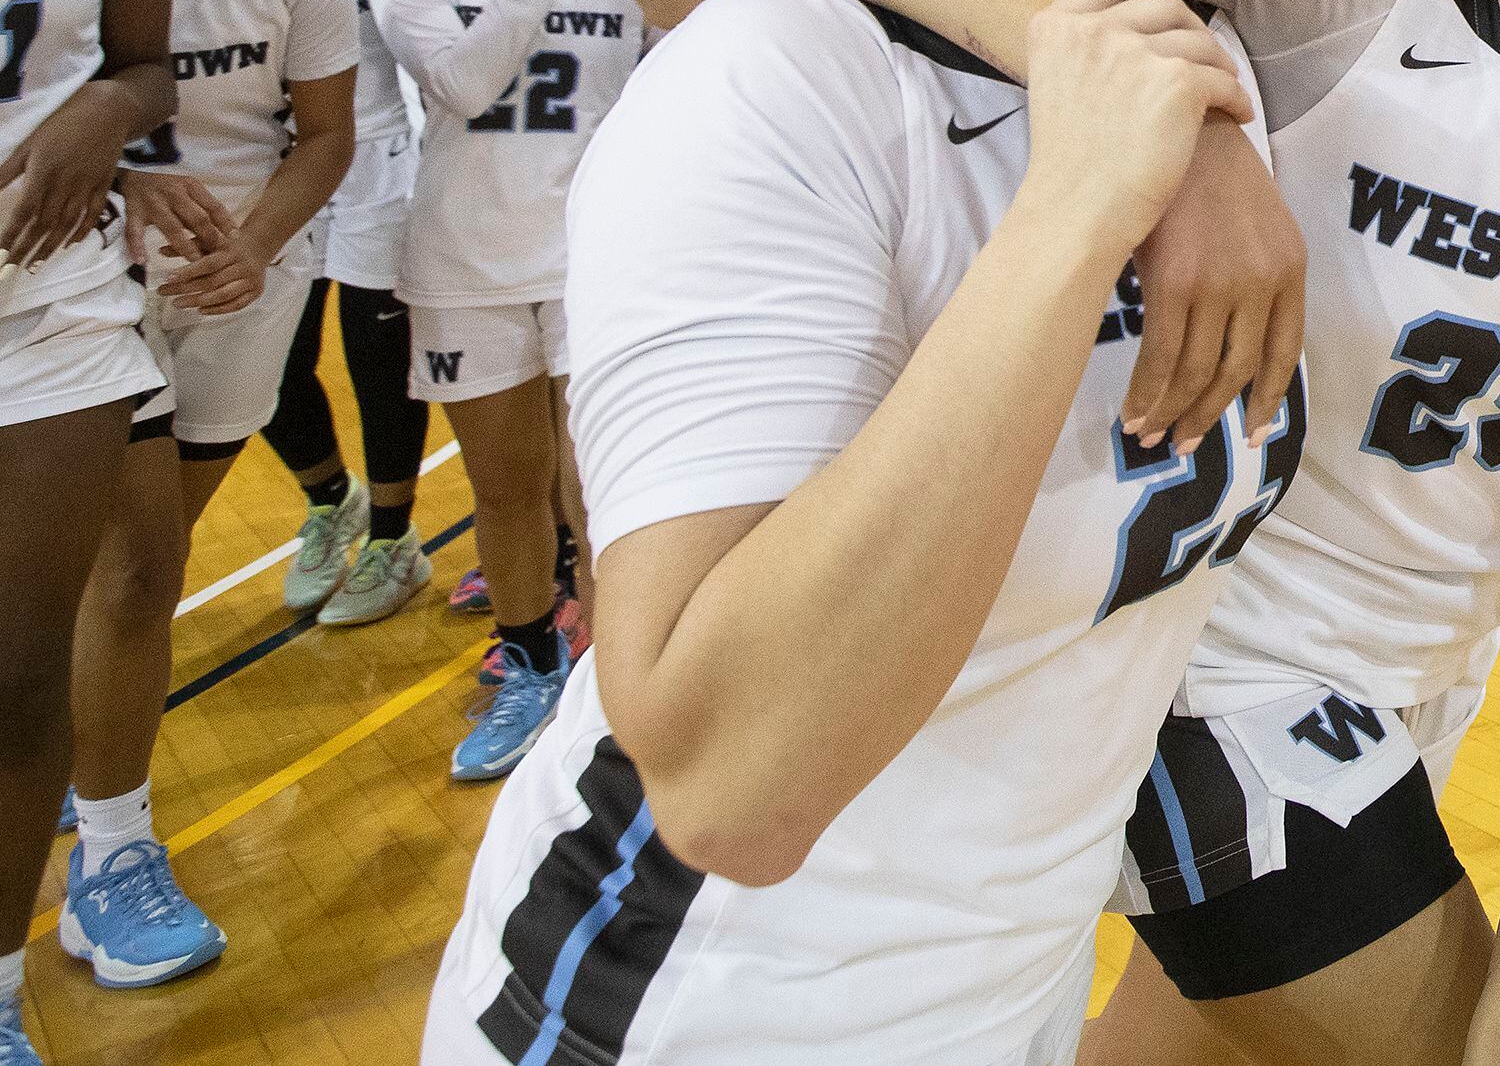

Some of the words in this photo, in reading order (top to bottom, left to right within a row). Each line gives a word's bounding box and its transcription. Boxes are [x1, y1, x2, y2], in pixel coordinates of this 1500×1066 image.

[171, 41, 268, 81] OWN
[424, 350, 464, 384] W
[1286, 691, 1388, 764] W
